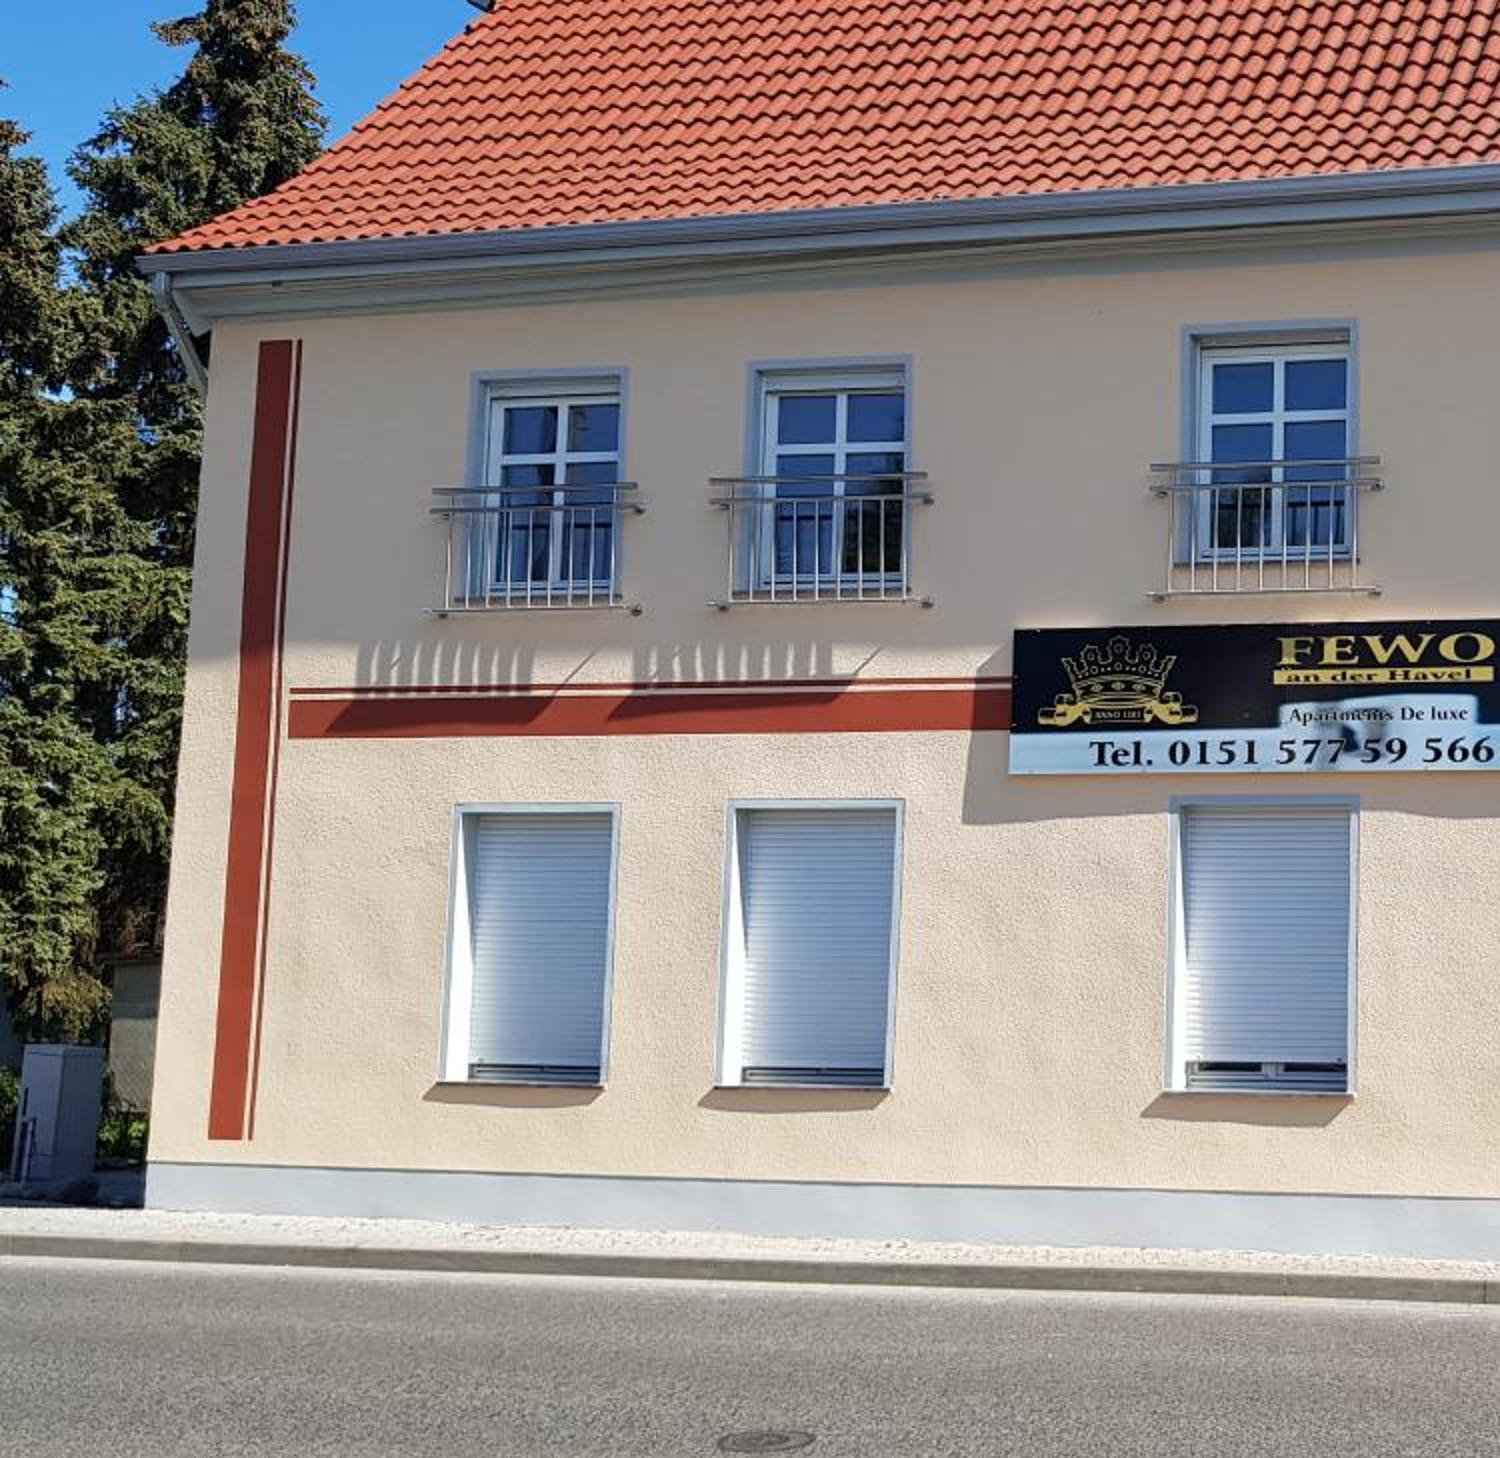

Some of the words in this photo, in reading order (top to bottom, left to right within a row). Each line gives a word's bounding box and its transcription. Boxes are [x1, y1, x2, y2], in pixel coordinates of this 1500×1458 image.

[1277, 632, 1496, 666] FEWO
[1286, 673, 1320, 683] an
[1331, 671, 1379, 682] der
[1389, 669, 1472, 682] Havel
[1289, 707, 1394, 727] Apartments
[1401, 706, 1426, 721] De
[1431, 705, 1468, 721] luxe
[1089, 739, 1153, 766] Tel.
[1168, 739, 1258, 766] 0151
[1276, 738, 1346, 765] 577
[1360, 737, 1408, 764] 59
[1422, 736, 1495, 763] 566
